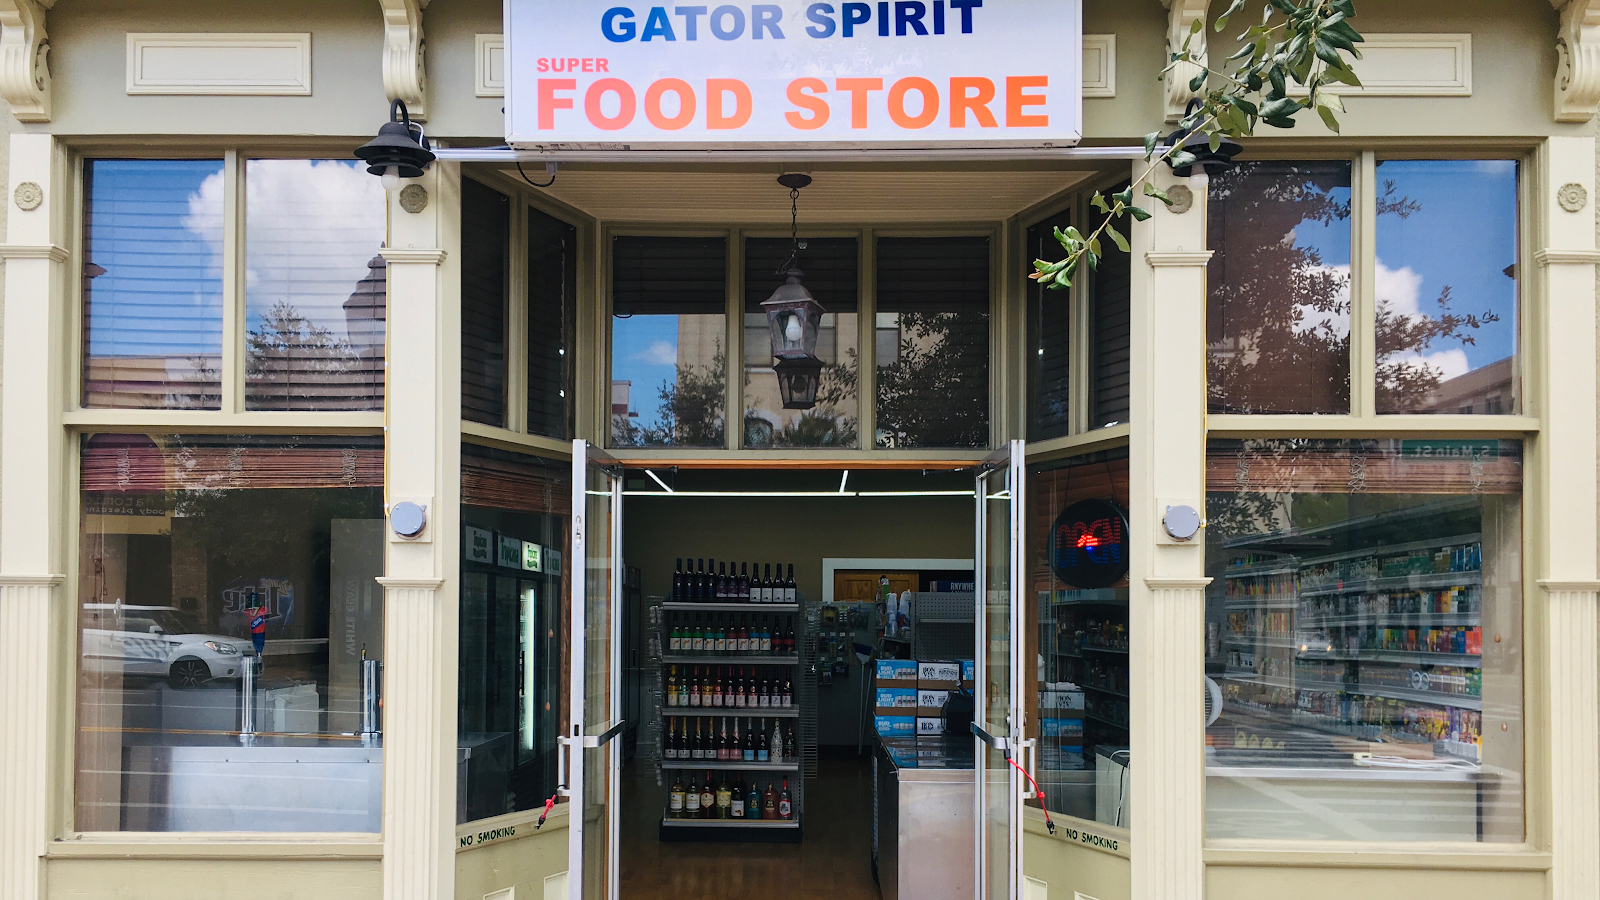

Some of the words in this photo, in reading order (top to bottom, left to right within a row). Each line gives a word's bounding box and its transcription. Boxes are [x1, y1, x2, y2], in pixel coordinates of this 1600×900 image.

[600, 4, 786, 43] GATOR
[805, 0, 983, 40] SPIRIT
[536, 57, 609, 73] SUPER
[536, 77, 753, 131] FOOD
[784, 75, 1049, 129] STORE
[1055, 516, 1121, 569] OPEN
[460, 835, 473, 847] NO
[477, 826, 516, 844] SMOKING
[1066, 828, 1078, 840] NO
[1081, 832, 1118, 850] SMOKING
